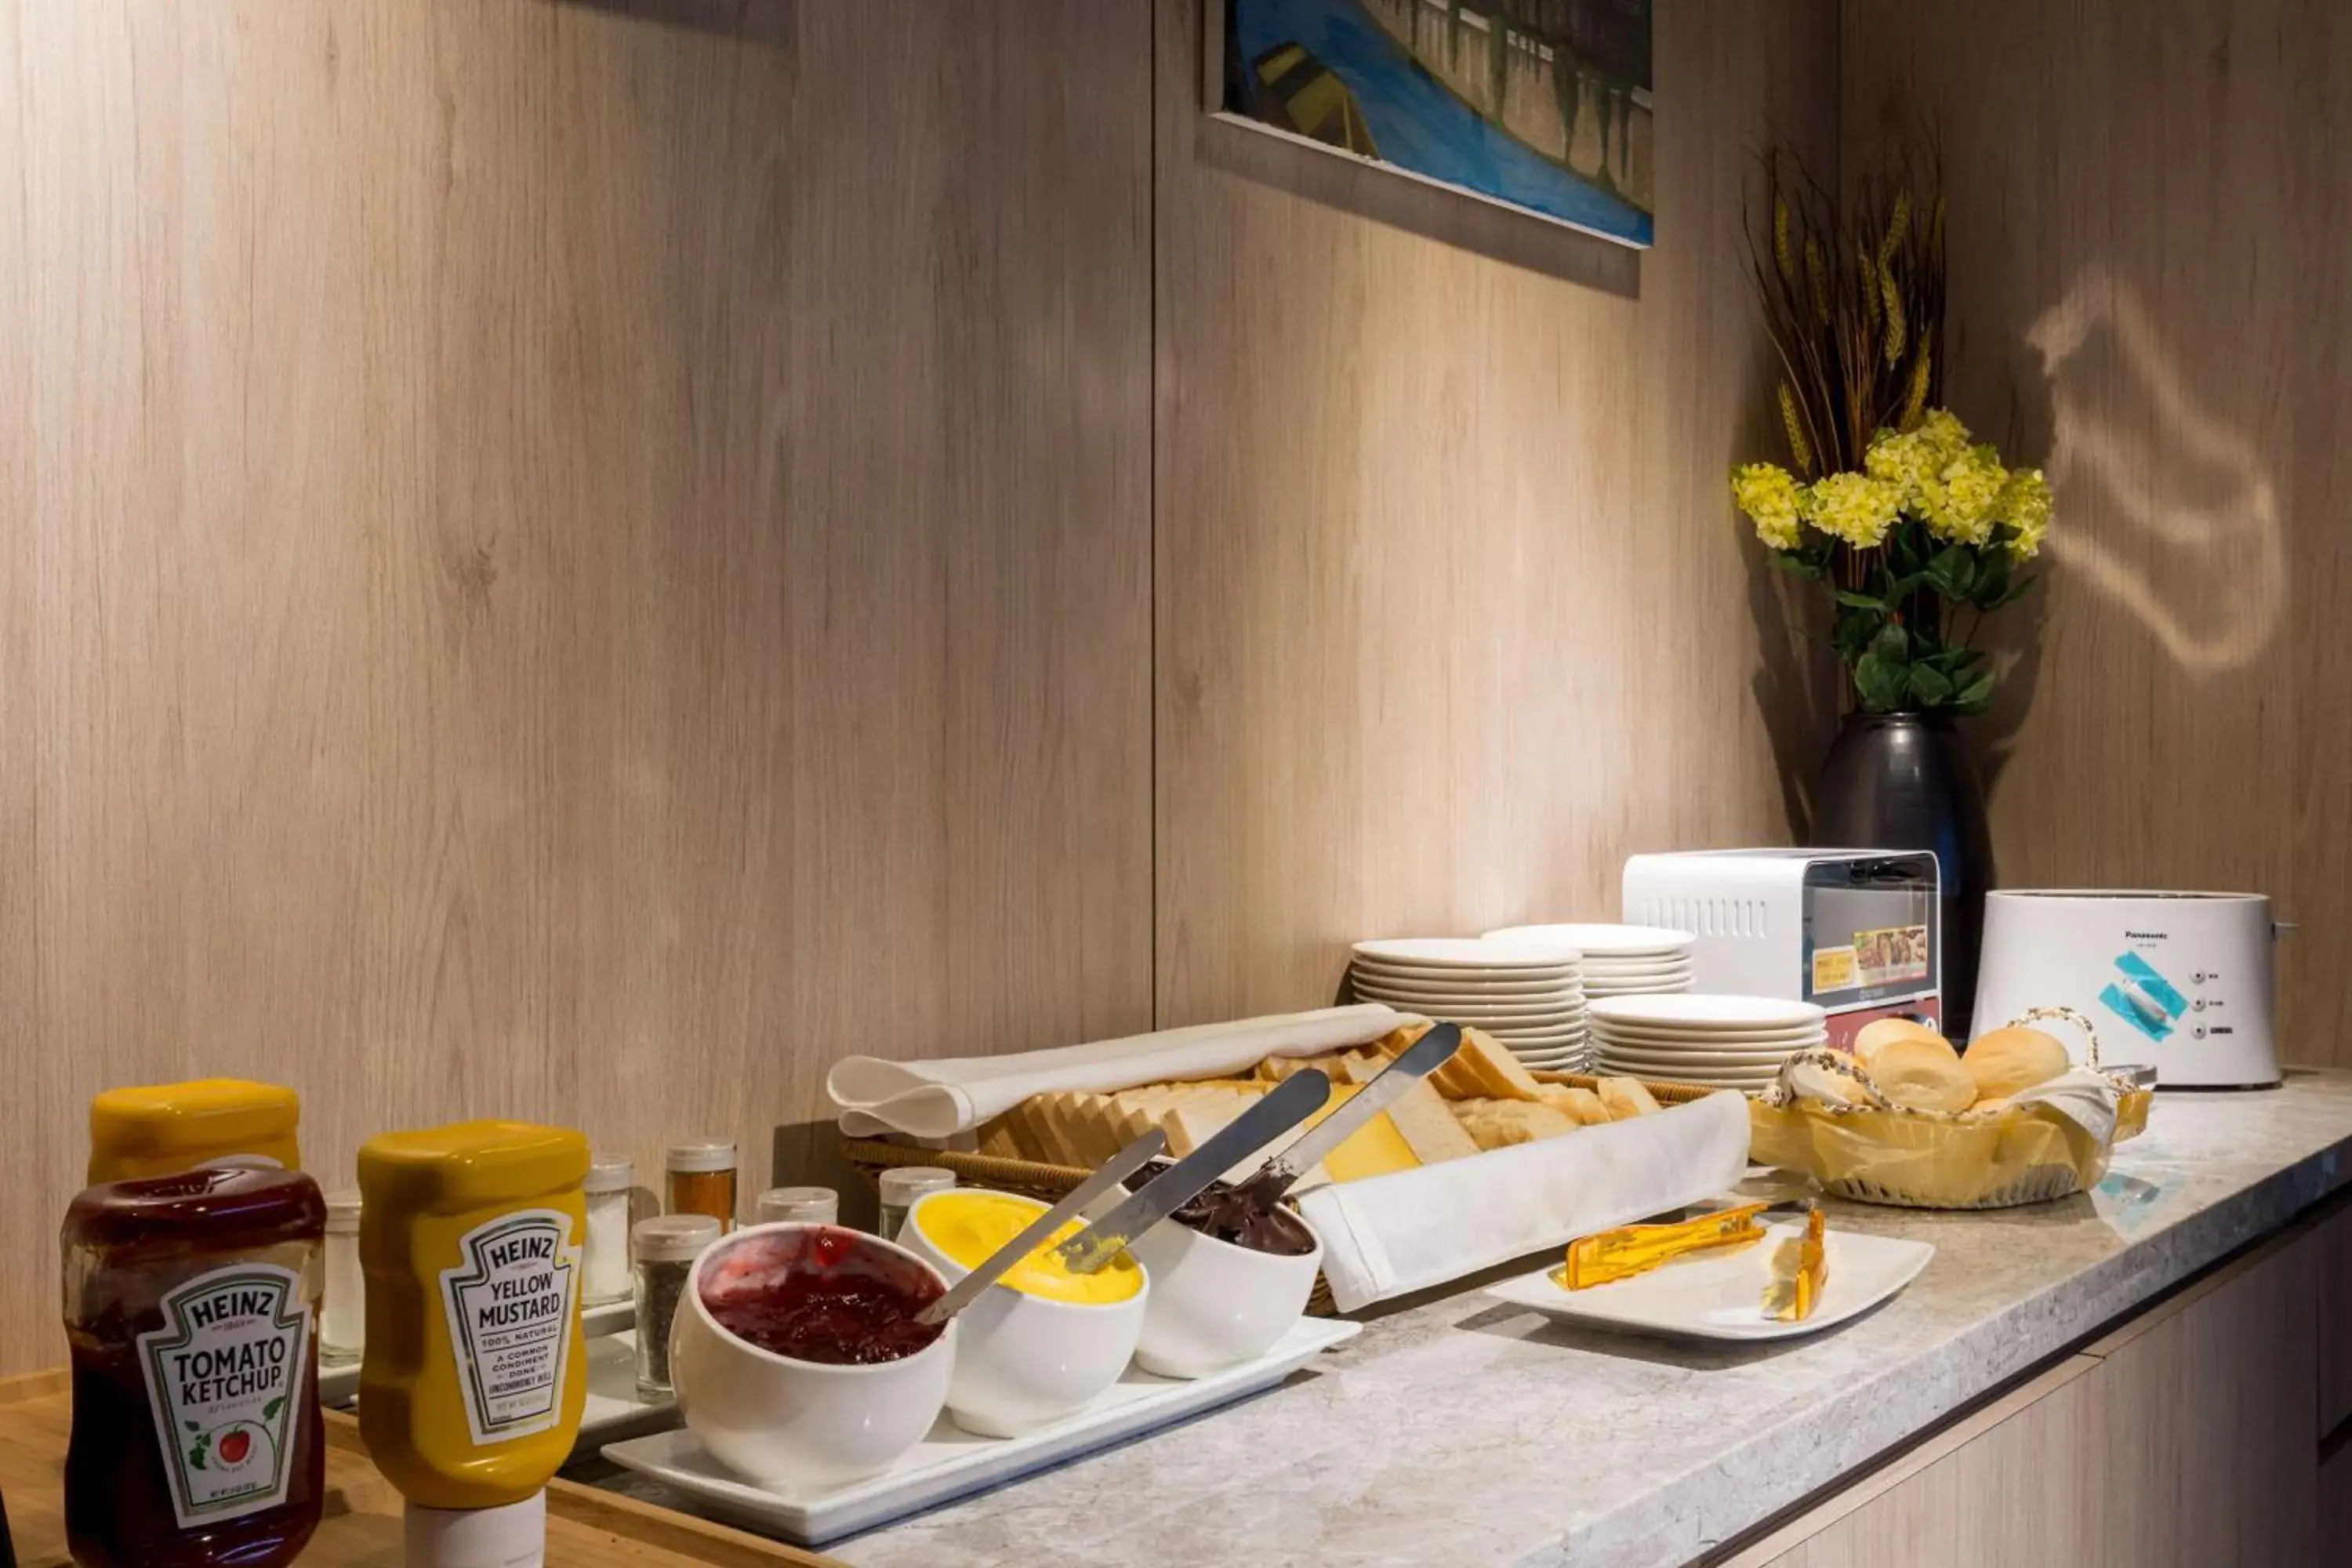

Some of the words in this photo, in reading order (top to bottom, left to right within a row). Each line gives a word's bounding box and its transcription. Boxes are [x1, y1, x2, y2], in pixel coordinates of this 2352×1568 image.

[491, 1236, 554, 1269] HEINZ
[491, 1271, 553, 1301] YELLOW
[191, 1291, 274, 1328] HEINZ
[479, 1292, 561, 1329] MUSTARD
[481, 1334, 510, 1348] 100%
[514, 1323, 557, 1341] NATURAL
[173, 1336, 285, 1382] TOMATO
[492, 1353, 549, 1372] CONDIMENT
[507, 1345, 548, 1360] COMMON
[183, 1366, 281, 1406] KETCHUP
